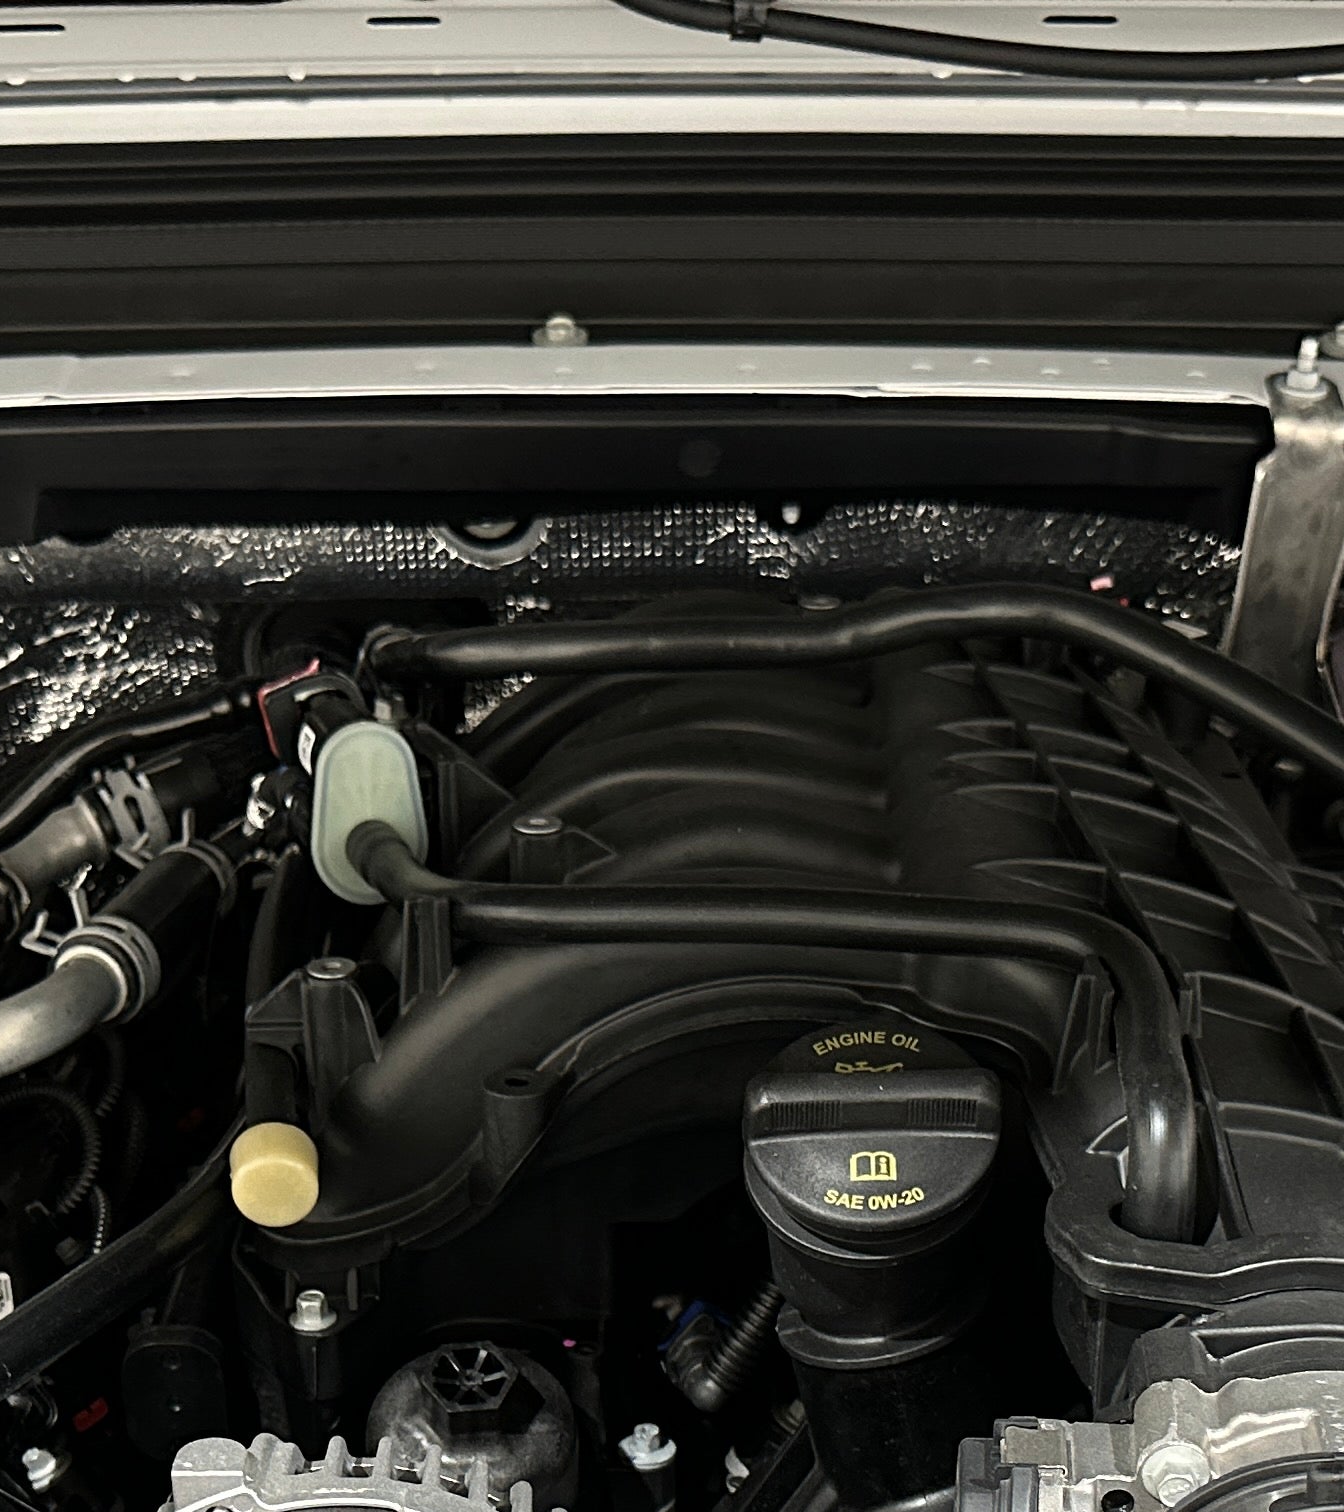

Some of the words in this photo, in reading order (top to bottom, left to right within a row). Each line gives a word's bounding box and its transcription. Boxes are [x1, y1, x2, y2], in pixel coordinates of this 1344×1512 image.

[813, 1031, 886, 1056] ENGINE
[891, 1032, 922, 1053] OIL
[824, 1188, 864, 1210] SAE
[868, 1186, 925, 1211] 0W-20
